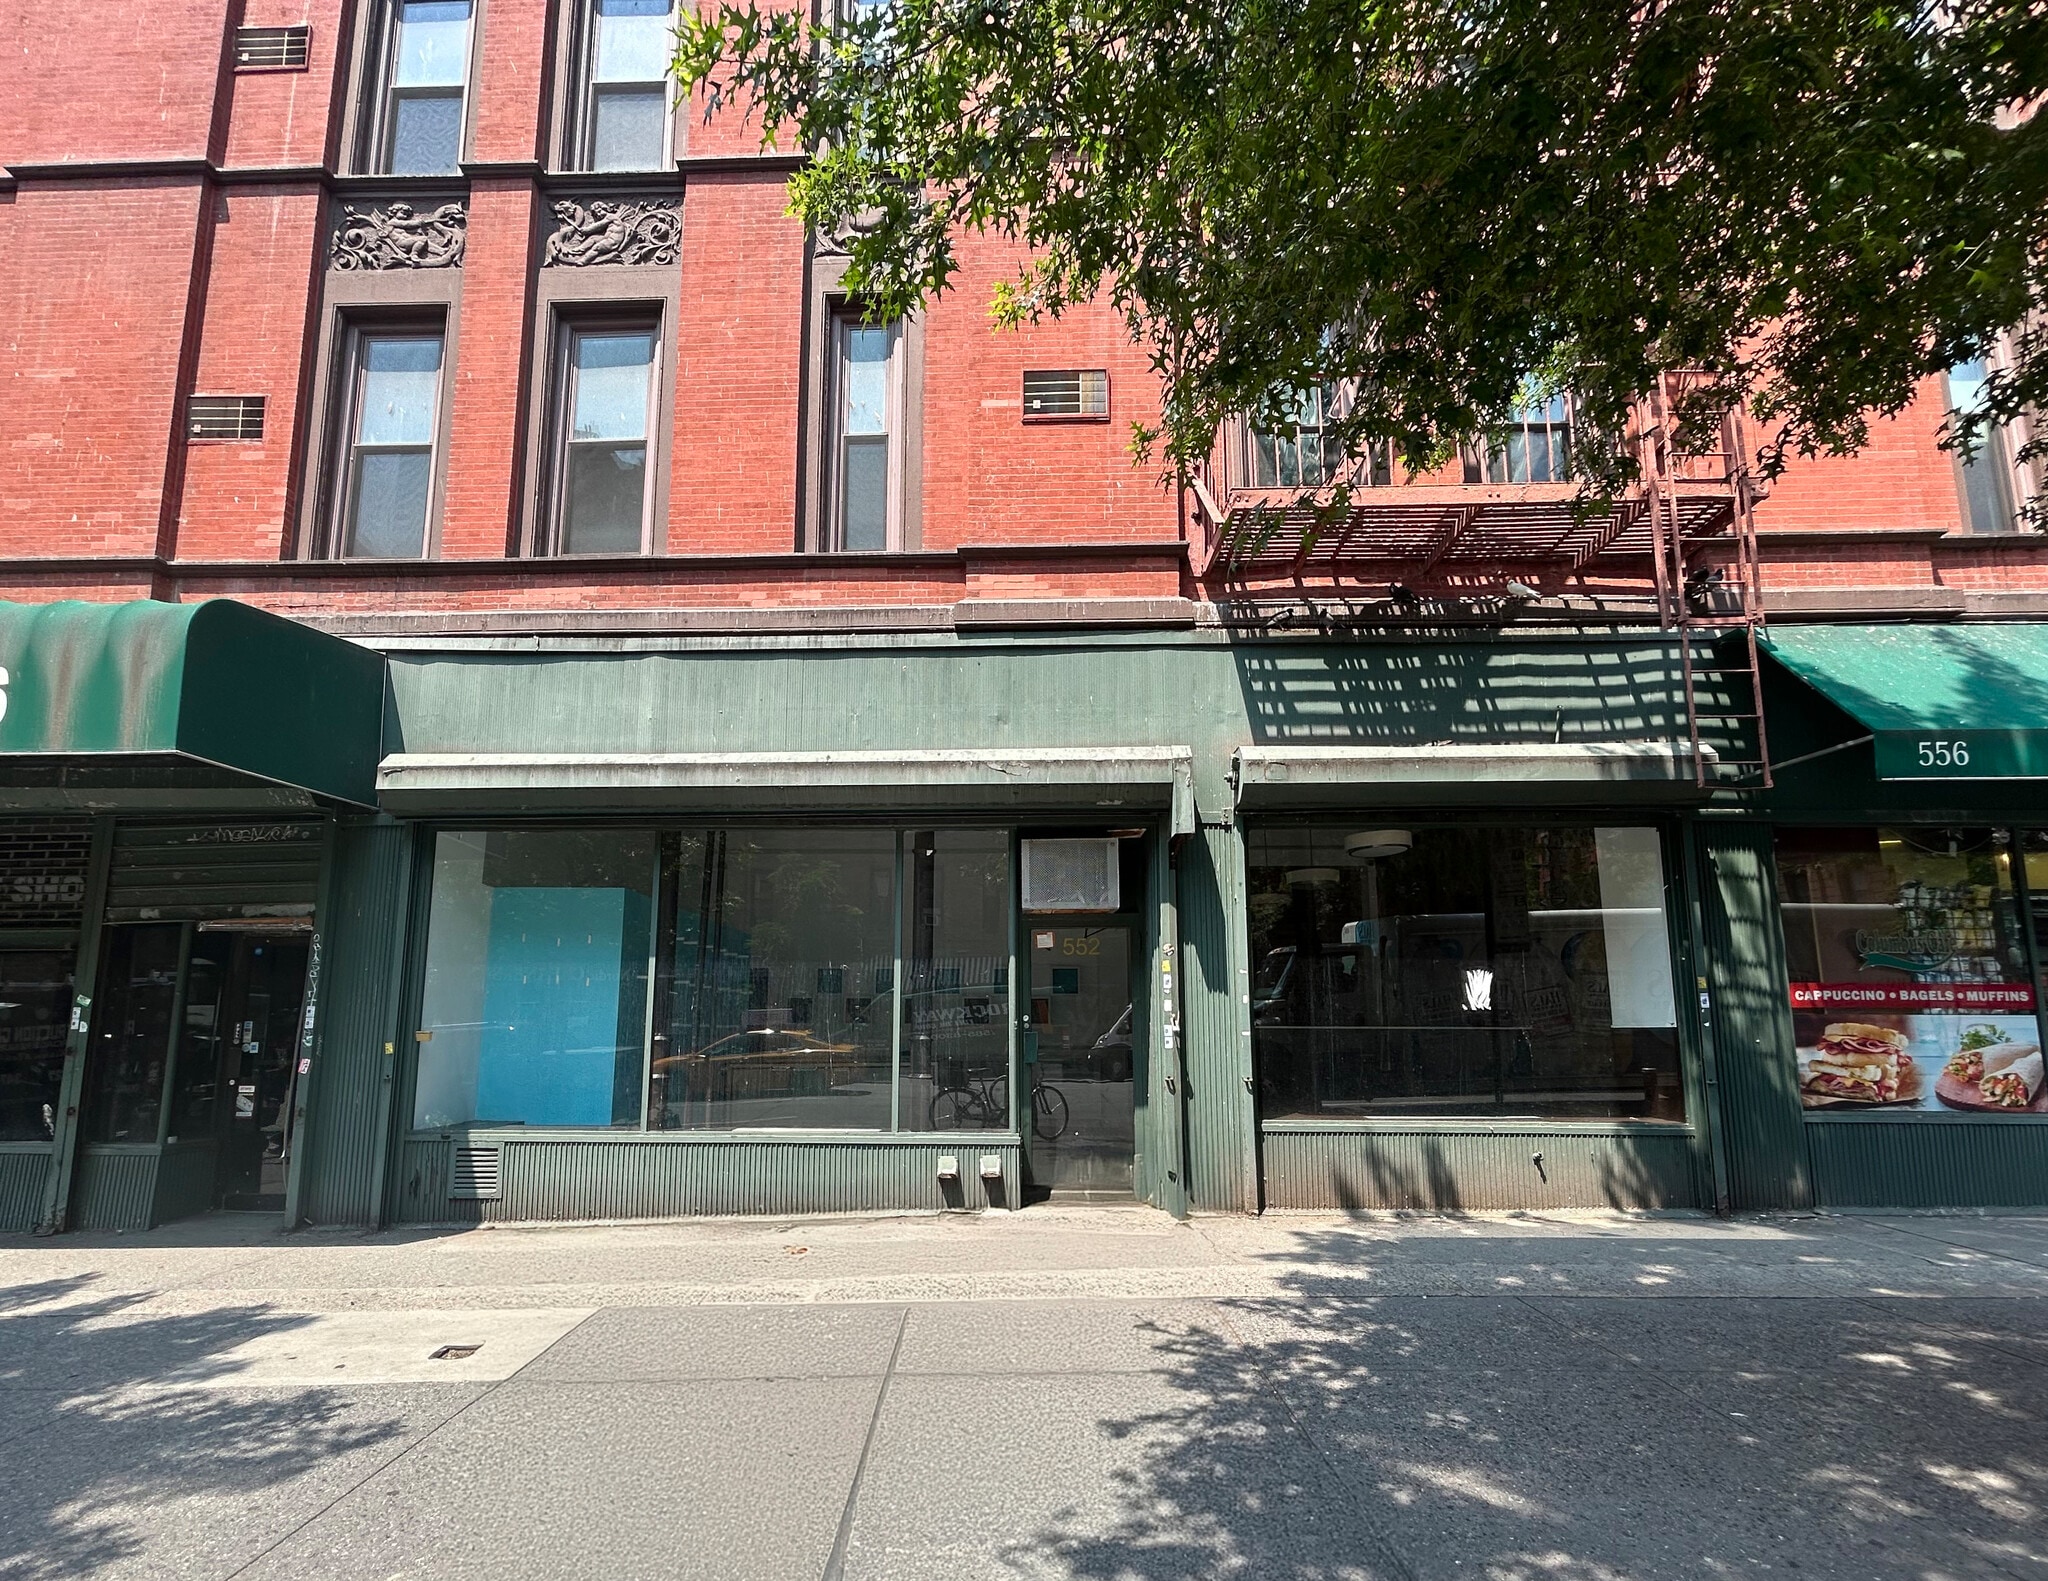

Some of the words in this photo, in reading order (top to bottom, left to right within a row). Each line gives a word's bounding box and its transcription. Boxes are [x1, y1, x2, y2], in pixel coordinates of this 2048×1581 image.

[1918, 741, 1970, 766] 556
[1062, 937, 1101, 956] 552
[1856, 929, 1925, 954] Columbus
[1794, 990, 1886, 1001] CAPPUCCINO
[1900, 990, 1955, 1001] BAGELS
[1966, 991, 2029, 1002] MUFFINS
